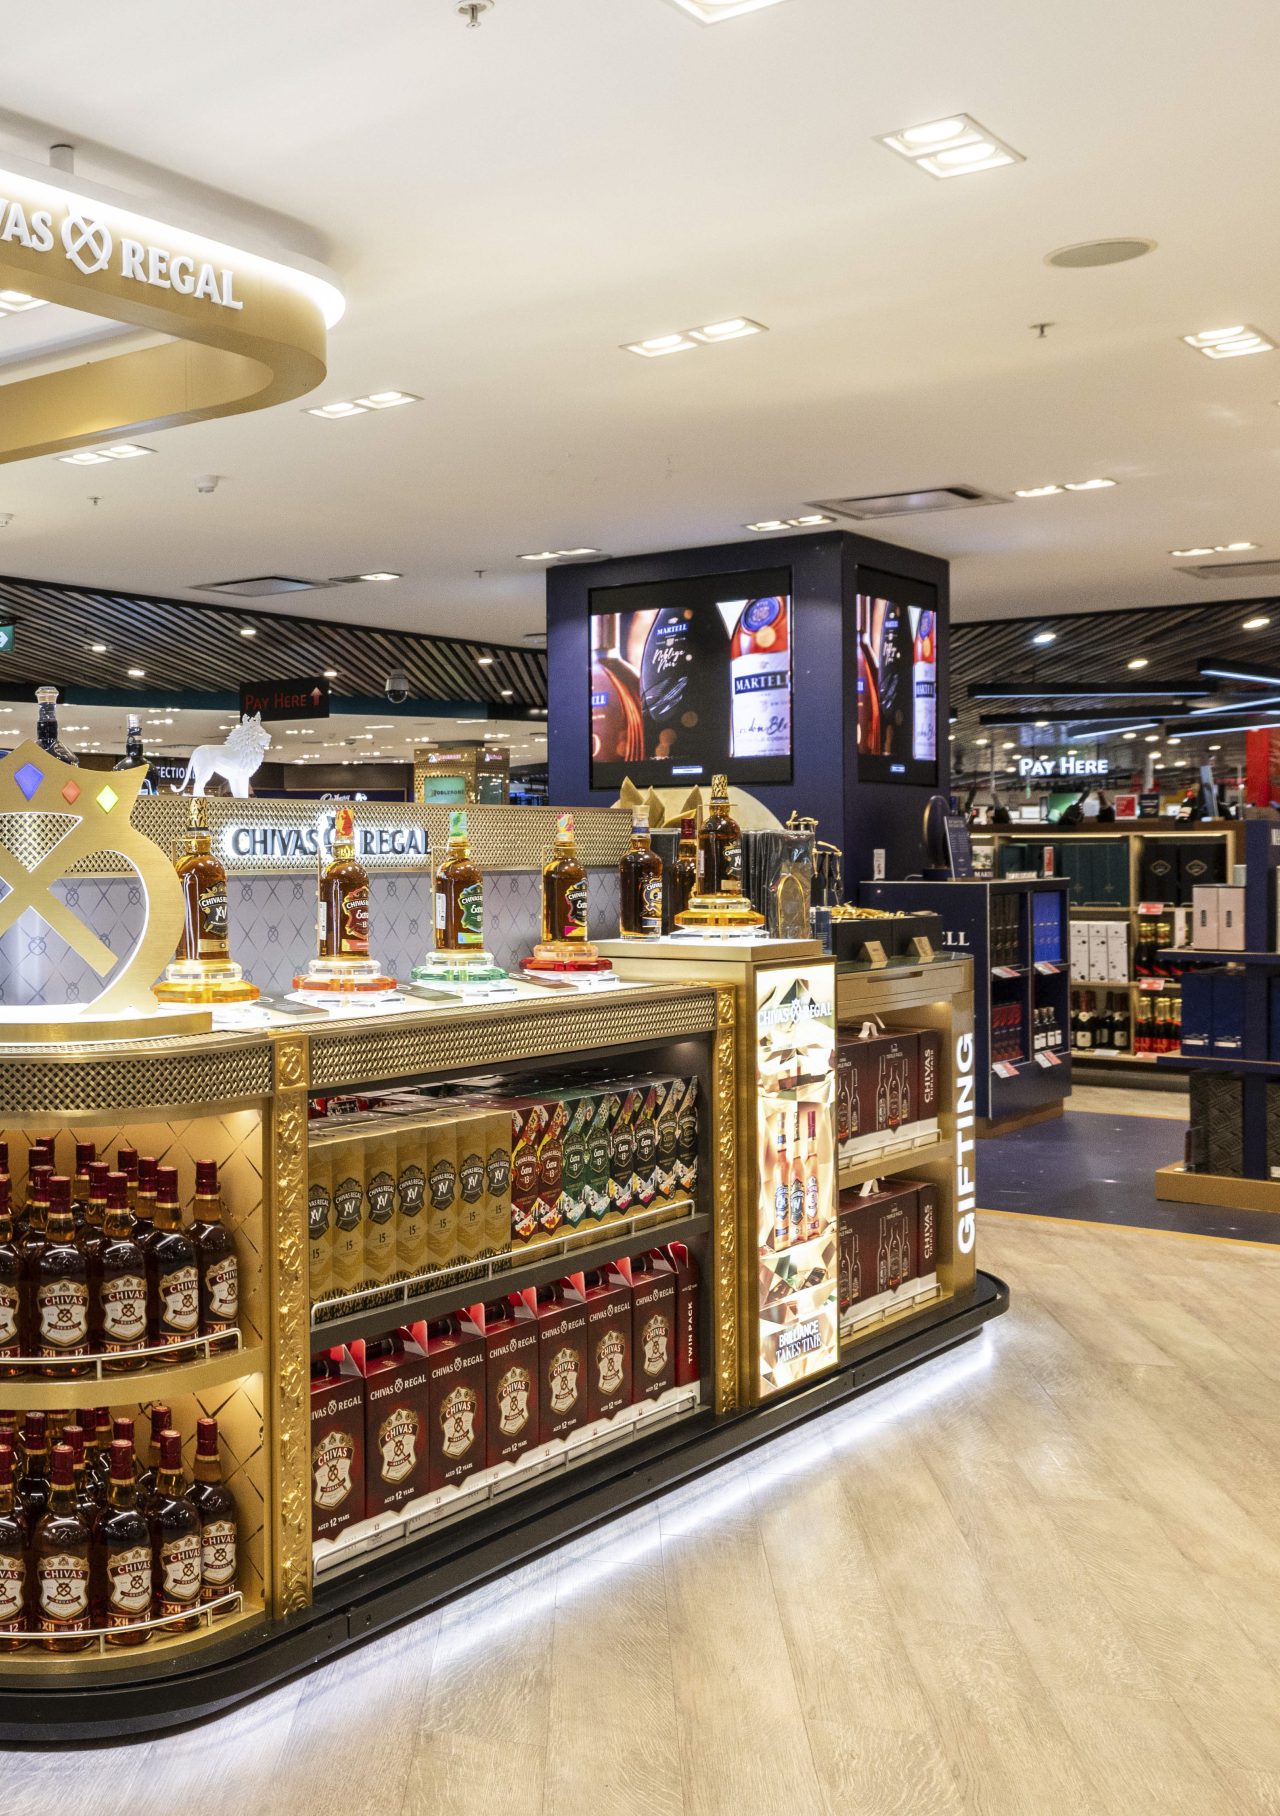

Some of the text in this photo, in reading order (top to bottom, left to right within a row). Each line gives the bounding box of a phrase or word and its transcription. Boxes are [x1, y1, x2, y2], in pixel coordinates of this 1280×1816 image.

[121, 237, 243, 310] REGAL
[657, 623, 688, 635] MARTELL
[244, 692, 307, 711] PAY HERE
[1019, 756, 1109, 776] PAY HERE
[231, 829, 432, 857] CHIVAS REGAL
[618, 1142, 628, 1152] Extra
[956, 1032, 976, 1255] GIFTING
[546, 1160, 557, 1170] Extra
[570, 1154, 580, 1163] Extra
[521, 1166, 533, 1176] Extra
[399, 1179, 424, 1190] CHIVAS REGAL
[468, 1174, 478, 1189] XV
[368, 1186, 395, 1197] CHIVAS REGAL
[407, 1187, 419, 1202] XV
[344, 1201, 355, 1216] XV
[376, 1194, 388, 1209] XV
[378, 1233, 386, 1242] 15
[409, 1225, 416, 1235] 15
[346, 1240, 353, 1249] 15
[45, 1296, 84, 1306] CHIVAS
[108, 1290, 145, 1301] CHIVAS
[589, 1301, 631, 1323] CHIVAS REGAL
[541, 1317, 586, 1340] CHIVAS REGAL
[779, 1320, 819, 1348] BRILLIANCE
[489, 1335, 537, 1359] CHIVAS REGAL
[776, 1341, 801, 1363] TAKES
[431, 1354, 484, 1379] CHIVAS REGAL
[370, 1374, 427, 1401] CHIVAS REGAL
[502, 1381, 526, 1398] CHIVAS
[384, 1423, 413, 1442] CHIVAS
[318, 1447, 348, 1467] CHIVAS
[384, 1487, 415, 1504] AGED 12 YEARS
[317, 1513, 350, 1532] AGED 12 YEARS
[201, 1534, 235, 1545] CHIVAS
[170, 1548, 201, 1562] CHIVAS
[44, 1569, 84, 1579] CHIVAS
[9, 1623, 19, 1632] 12
